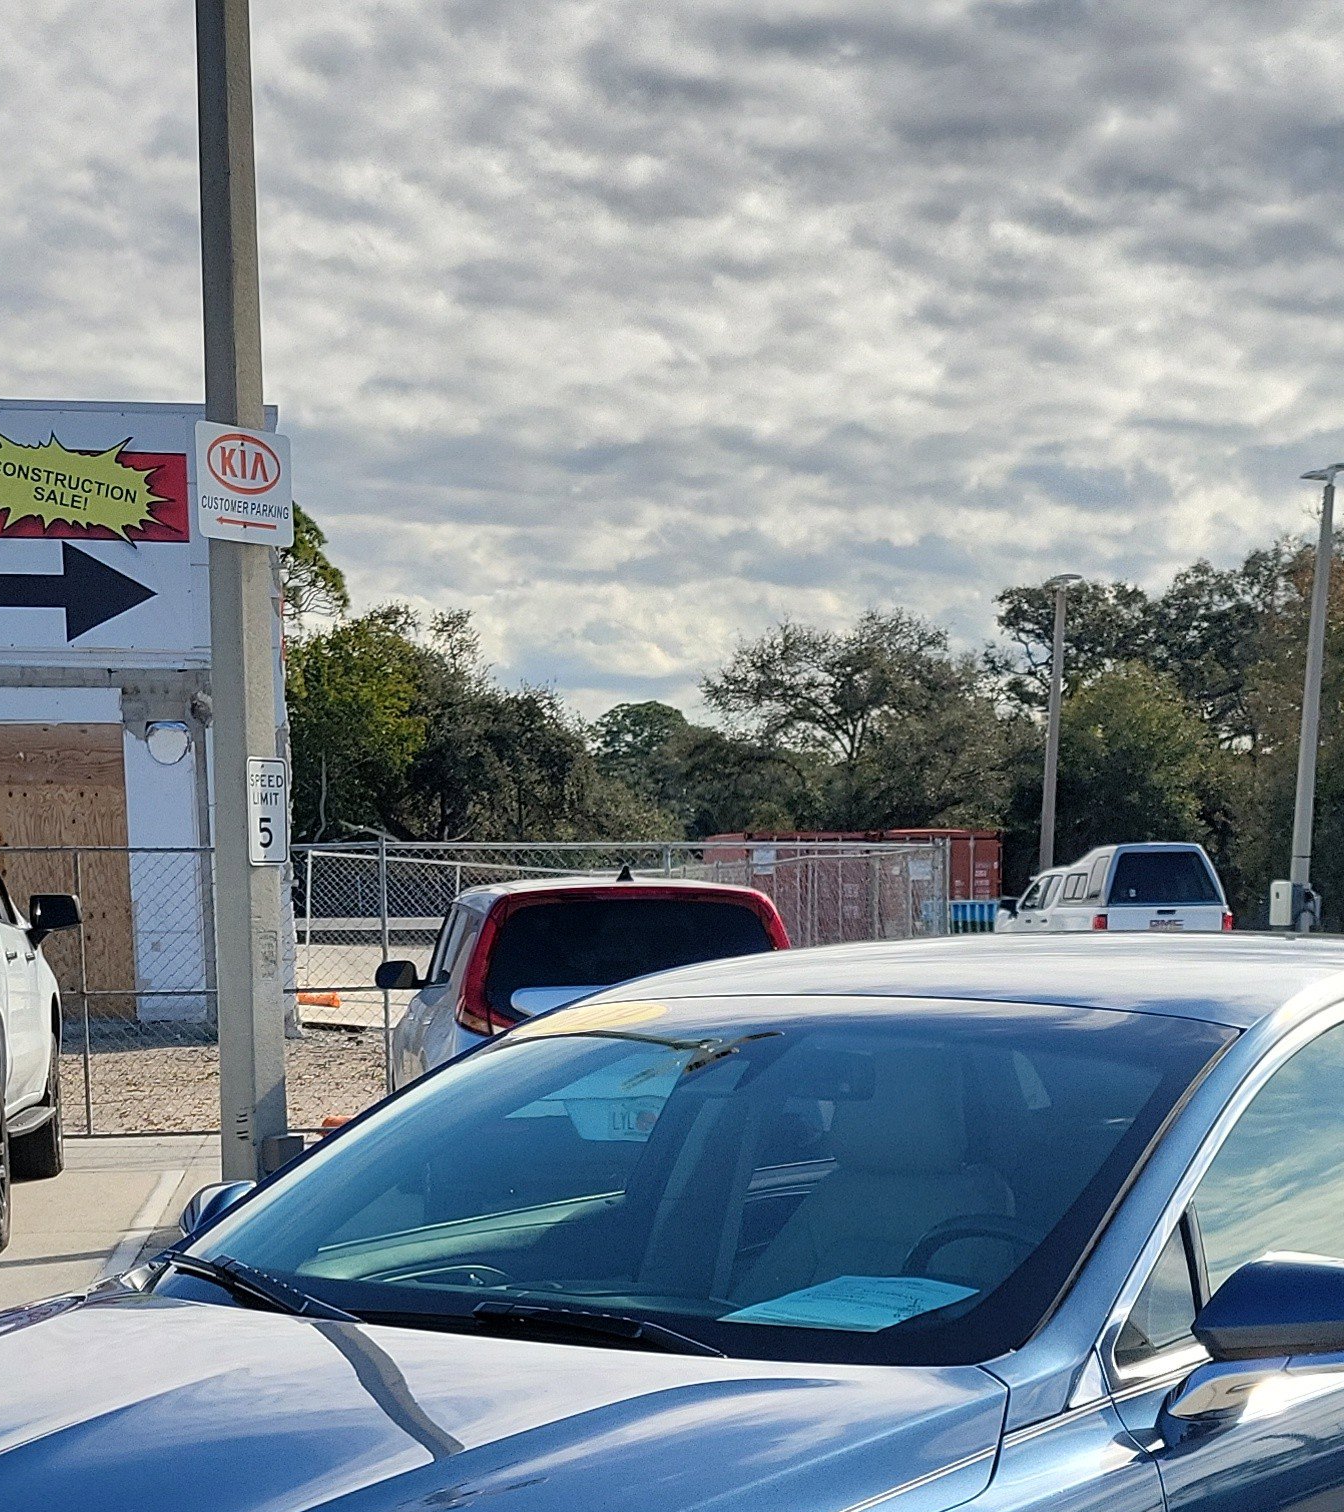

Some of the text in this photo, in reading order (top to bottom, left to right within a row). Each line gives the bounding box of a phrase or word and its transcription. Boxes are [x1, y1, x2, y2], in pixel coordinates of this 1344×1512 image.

[220, 446, 269, 482] KIA
[33, 486, 89, 511] SALE!
[201, 495, 289, 520] CUSTOMER PARKING
[250, 774, 284, 788] SPEED
[252, 792, 279, 806] LIMIT
[259, 817, 273, 848] 5
